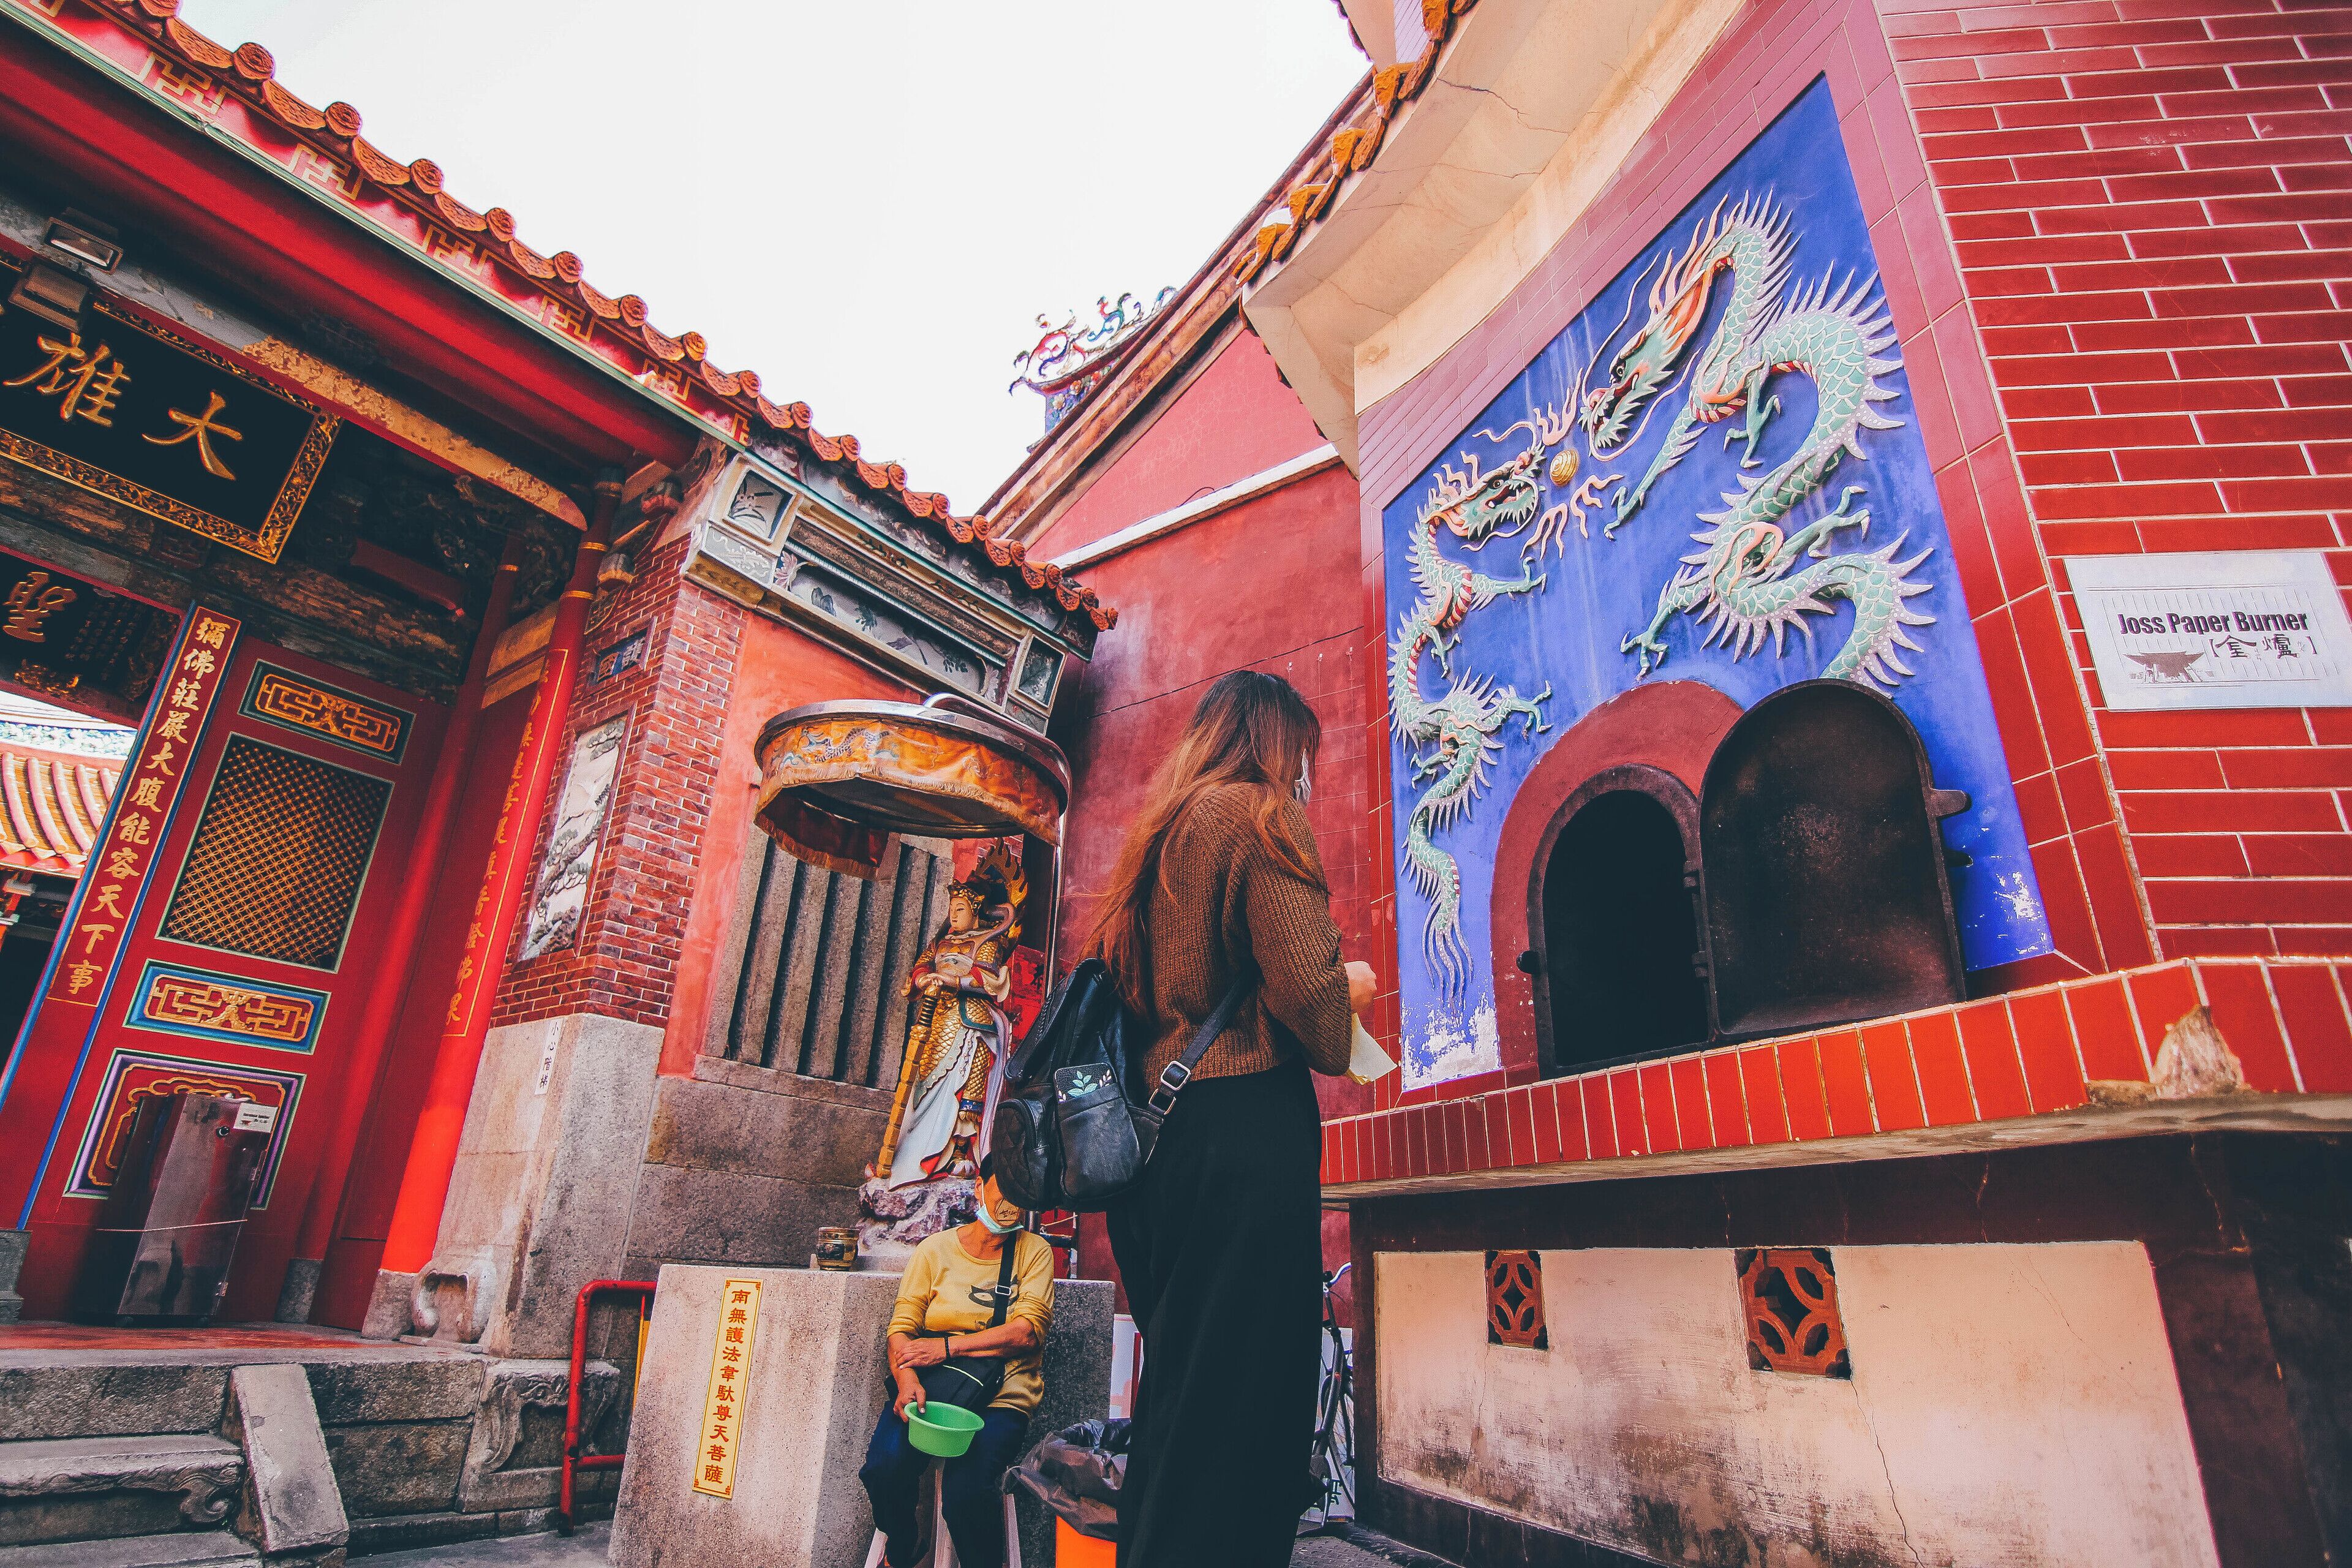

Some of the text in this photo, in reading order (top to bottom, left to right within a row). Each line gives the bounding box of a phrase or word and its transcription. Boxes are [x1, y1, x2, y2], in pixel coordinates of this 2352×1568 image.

[2117, 611, 2309, 635] Joss Paper Burner
